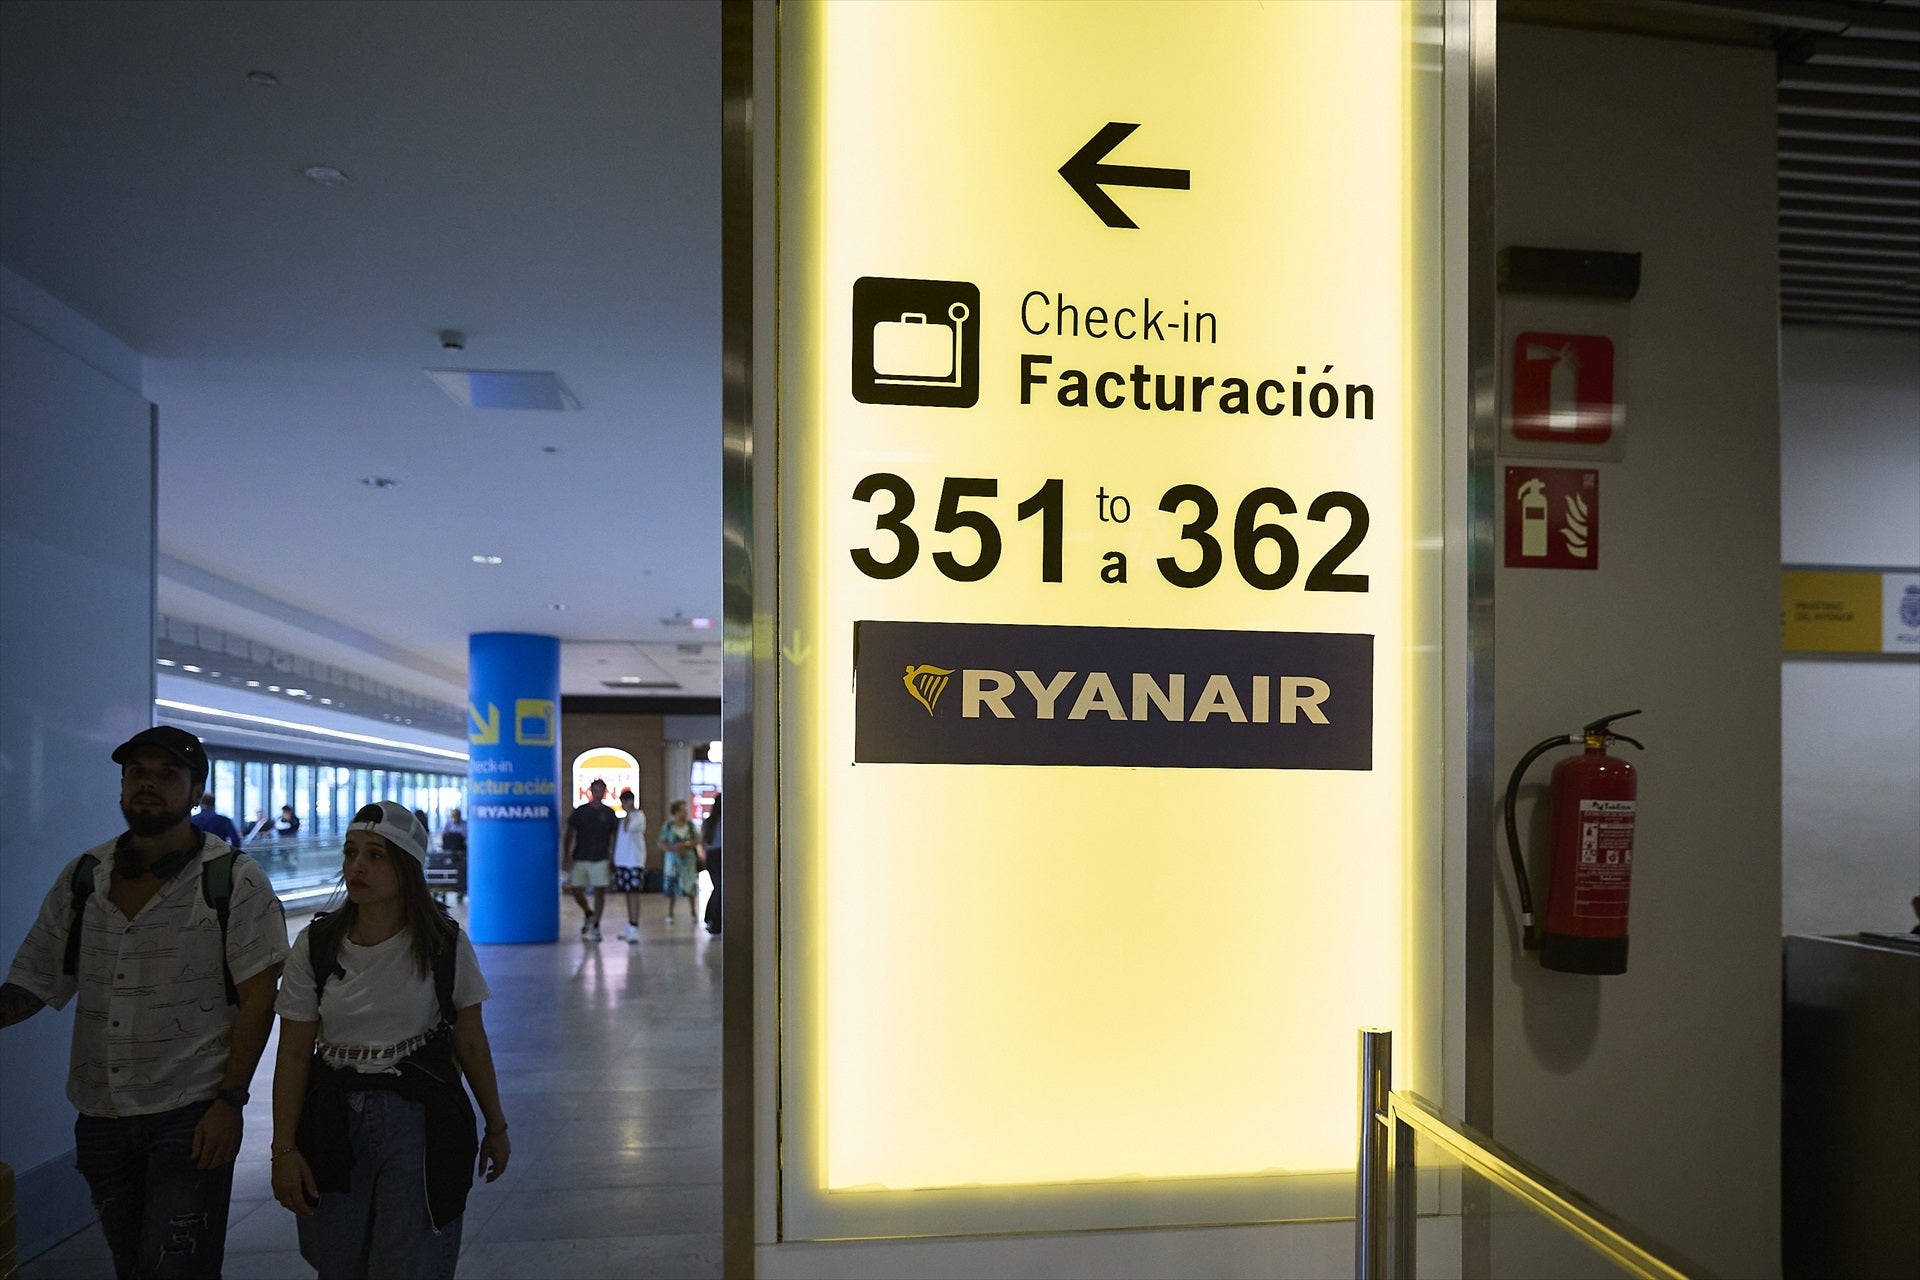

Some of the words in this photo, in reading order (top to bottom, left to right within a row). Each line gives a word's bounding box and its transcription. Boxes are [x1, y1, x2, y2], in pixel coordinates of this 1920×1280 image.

[1021, 290, 1217, 344] Check-in
[1020, 353, 1374, 420] Facturación
[849, 472, 1064, 584] 351
[1096, 486, 1131, 524] to
[1156, 483, 1370, 593] 362
[1100, 551, 1128, 584] a
[961, 669, 1331, 725] RYANAIR
[468, 778, 556, 796] acturación
[477, 805, 550, 818] RYANAIR
